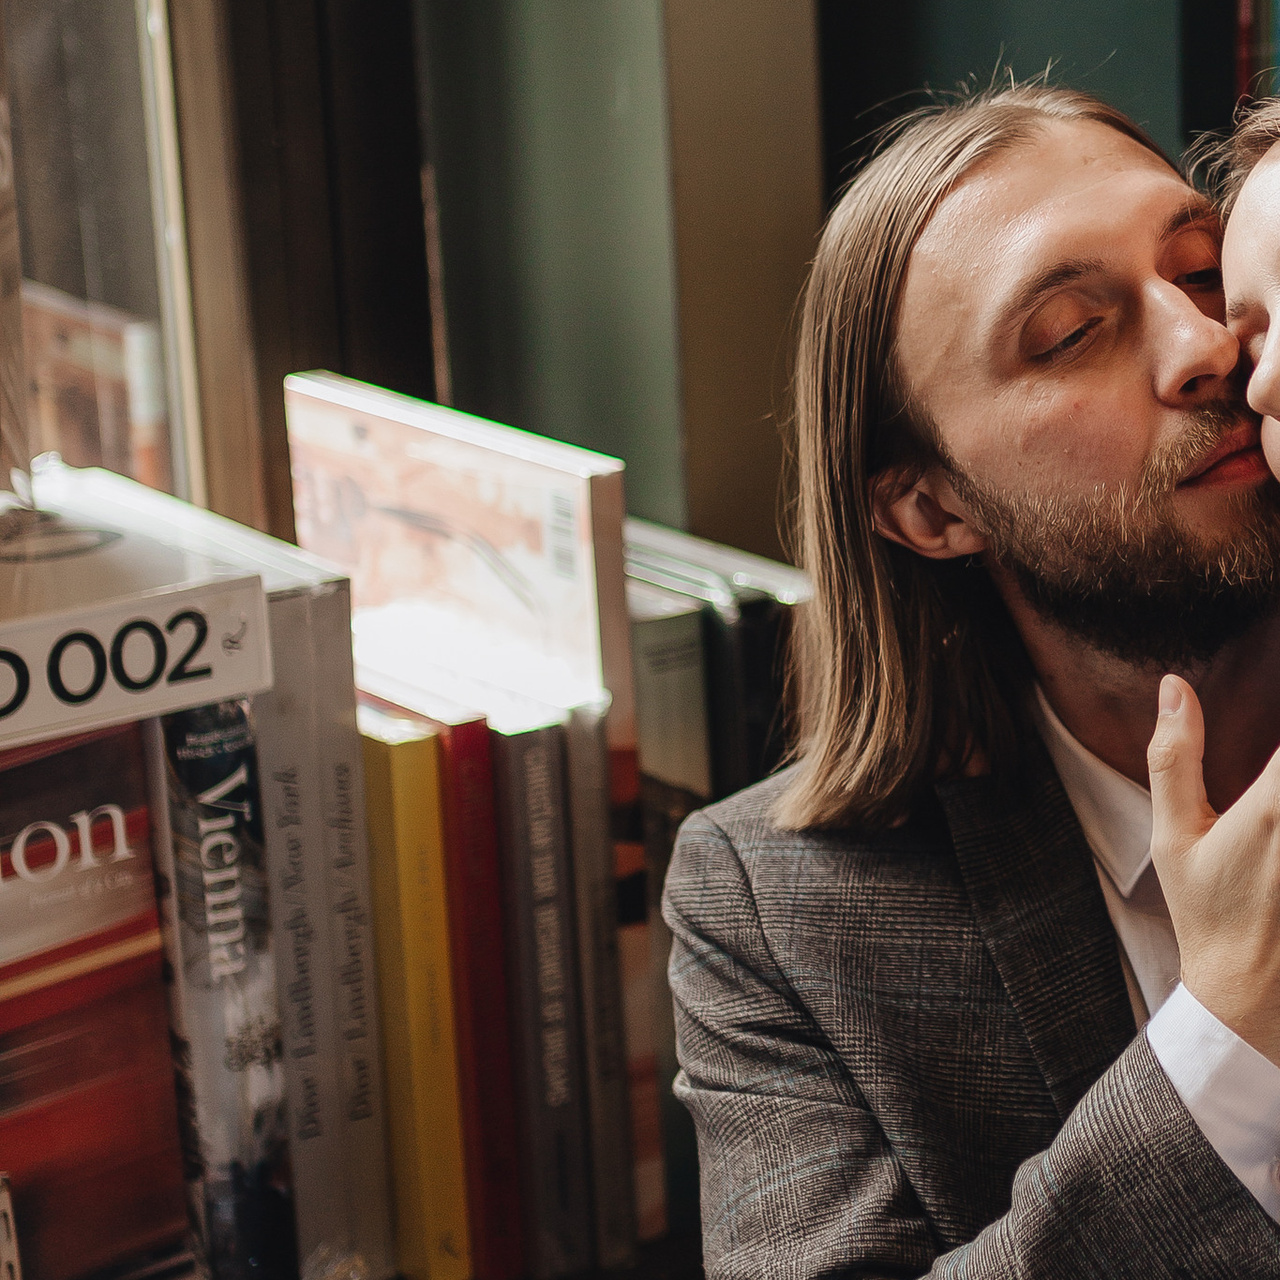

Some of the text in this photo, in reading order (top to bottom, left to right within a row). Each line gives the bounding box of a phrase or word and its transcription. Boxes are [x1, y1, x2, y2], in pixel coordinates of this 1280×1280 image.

[47, 611, 212, 705] 002
[0, 804, 136, 886] on
[198, 763, 251, 983] Vienna
